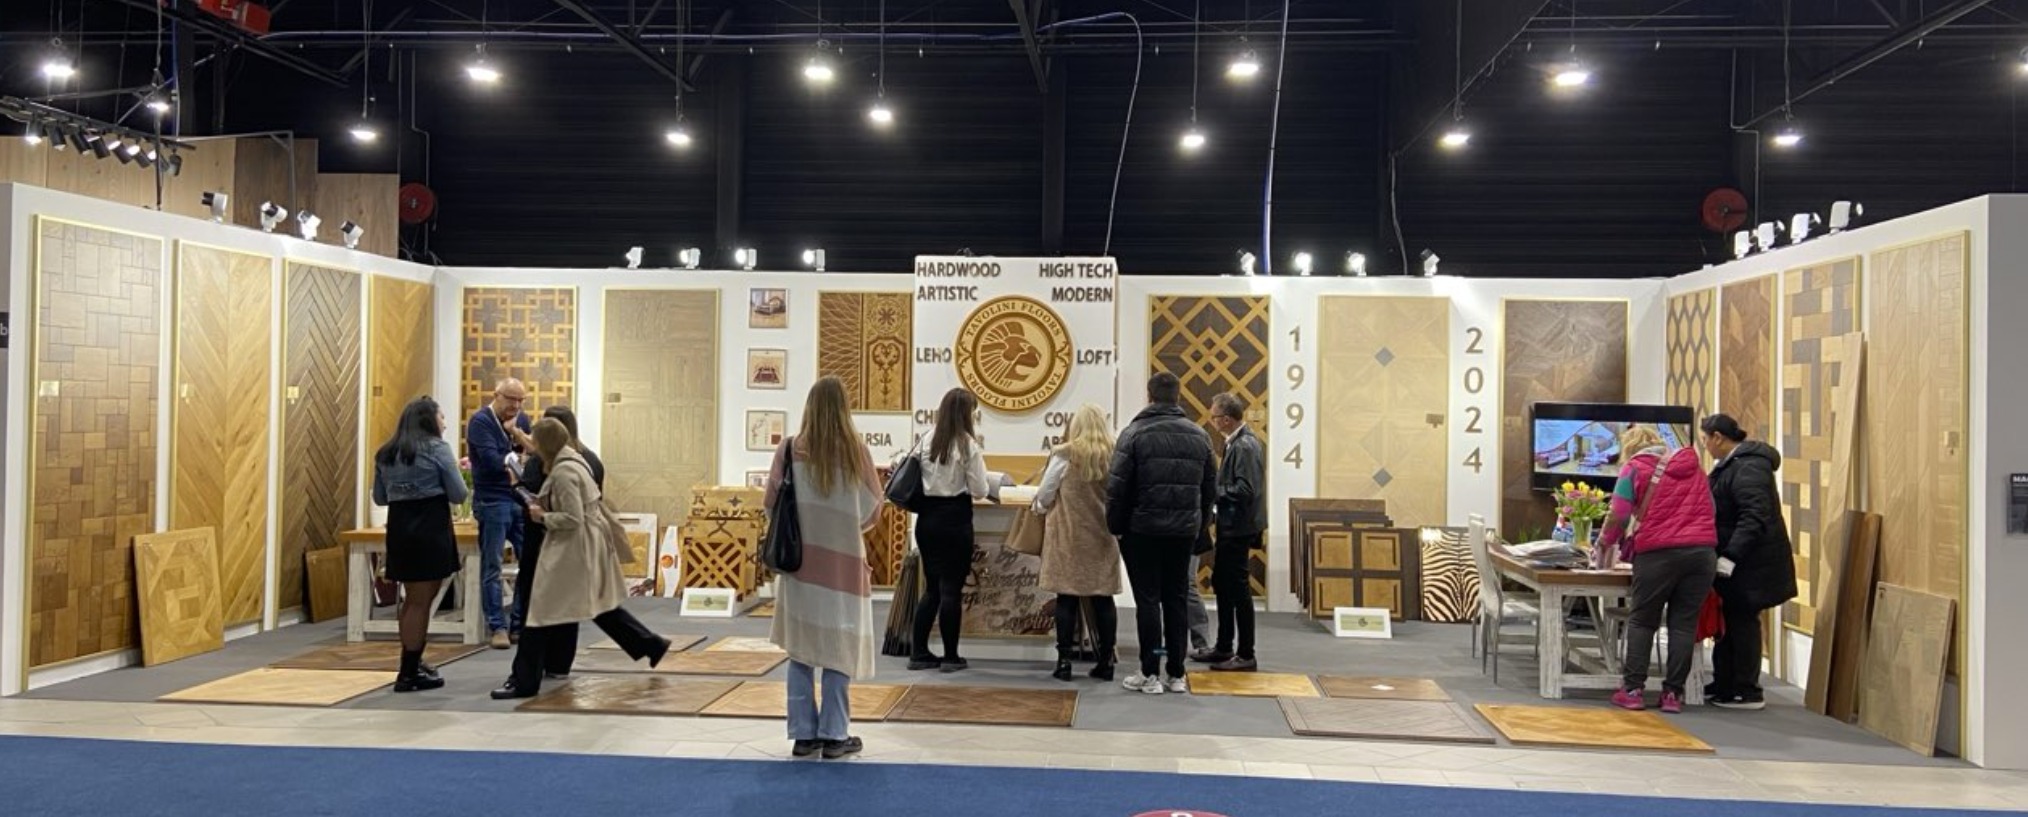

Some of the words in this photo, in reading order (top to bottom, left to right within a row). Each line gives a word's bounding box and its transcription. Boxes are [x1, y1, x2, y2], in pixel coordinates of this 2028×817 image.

[917, 262, 1001, 277] HARDWOOD
[1039, 263, 1073, 277] HIGH
[1077, 263, 1113, 278] TECH
[917, 286, 978, 301] ARTISTIC
[1052, 287, 1112, 302] MODERN
[966, 302, 1016, 337] TAVOLINI
[1021, 303, 1061, 336] FLOORS
[1077, 349, 1112, 365] LOFT
[966, 373, 1006, 407] FLOORS
[1012, 372, 1062, 407] TAVOLINI
